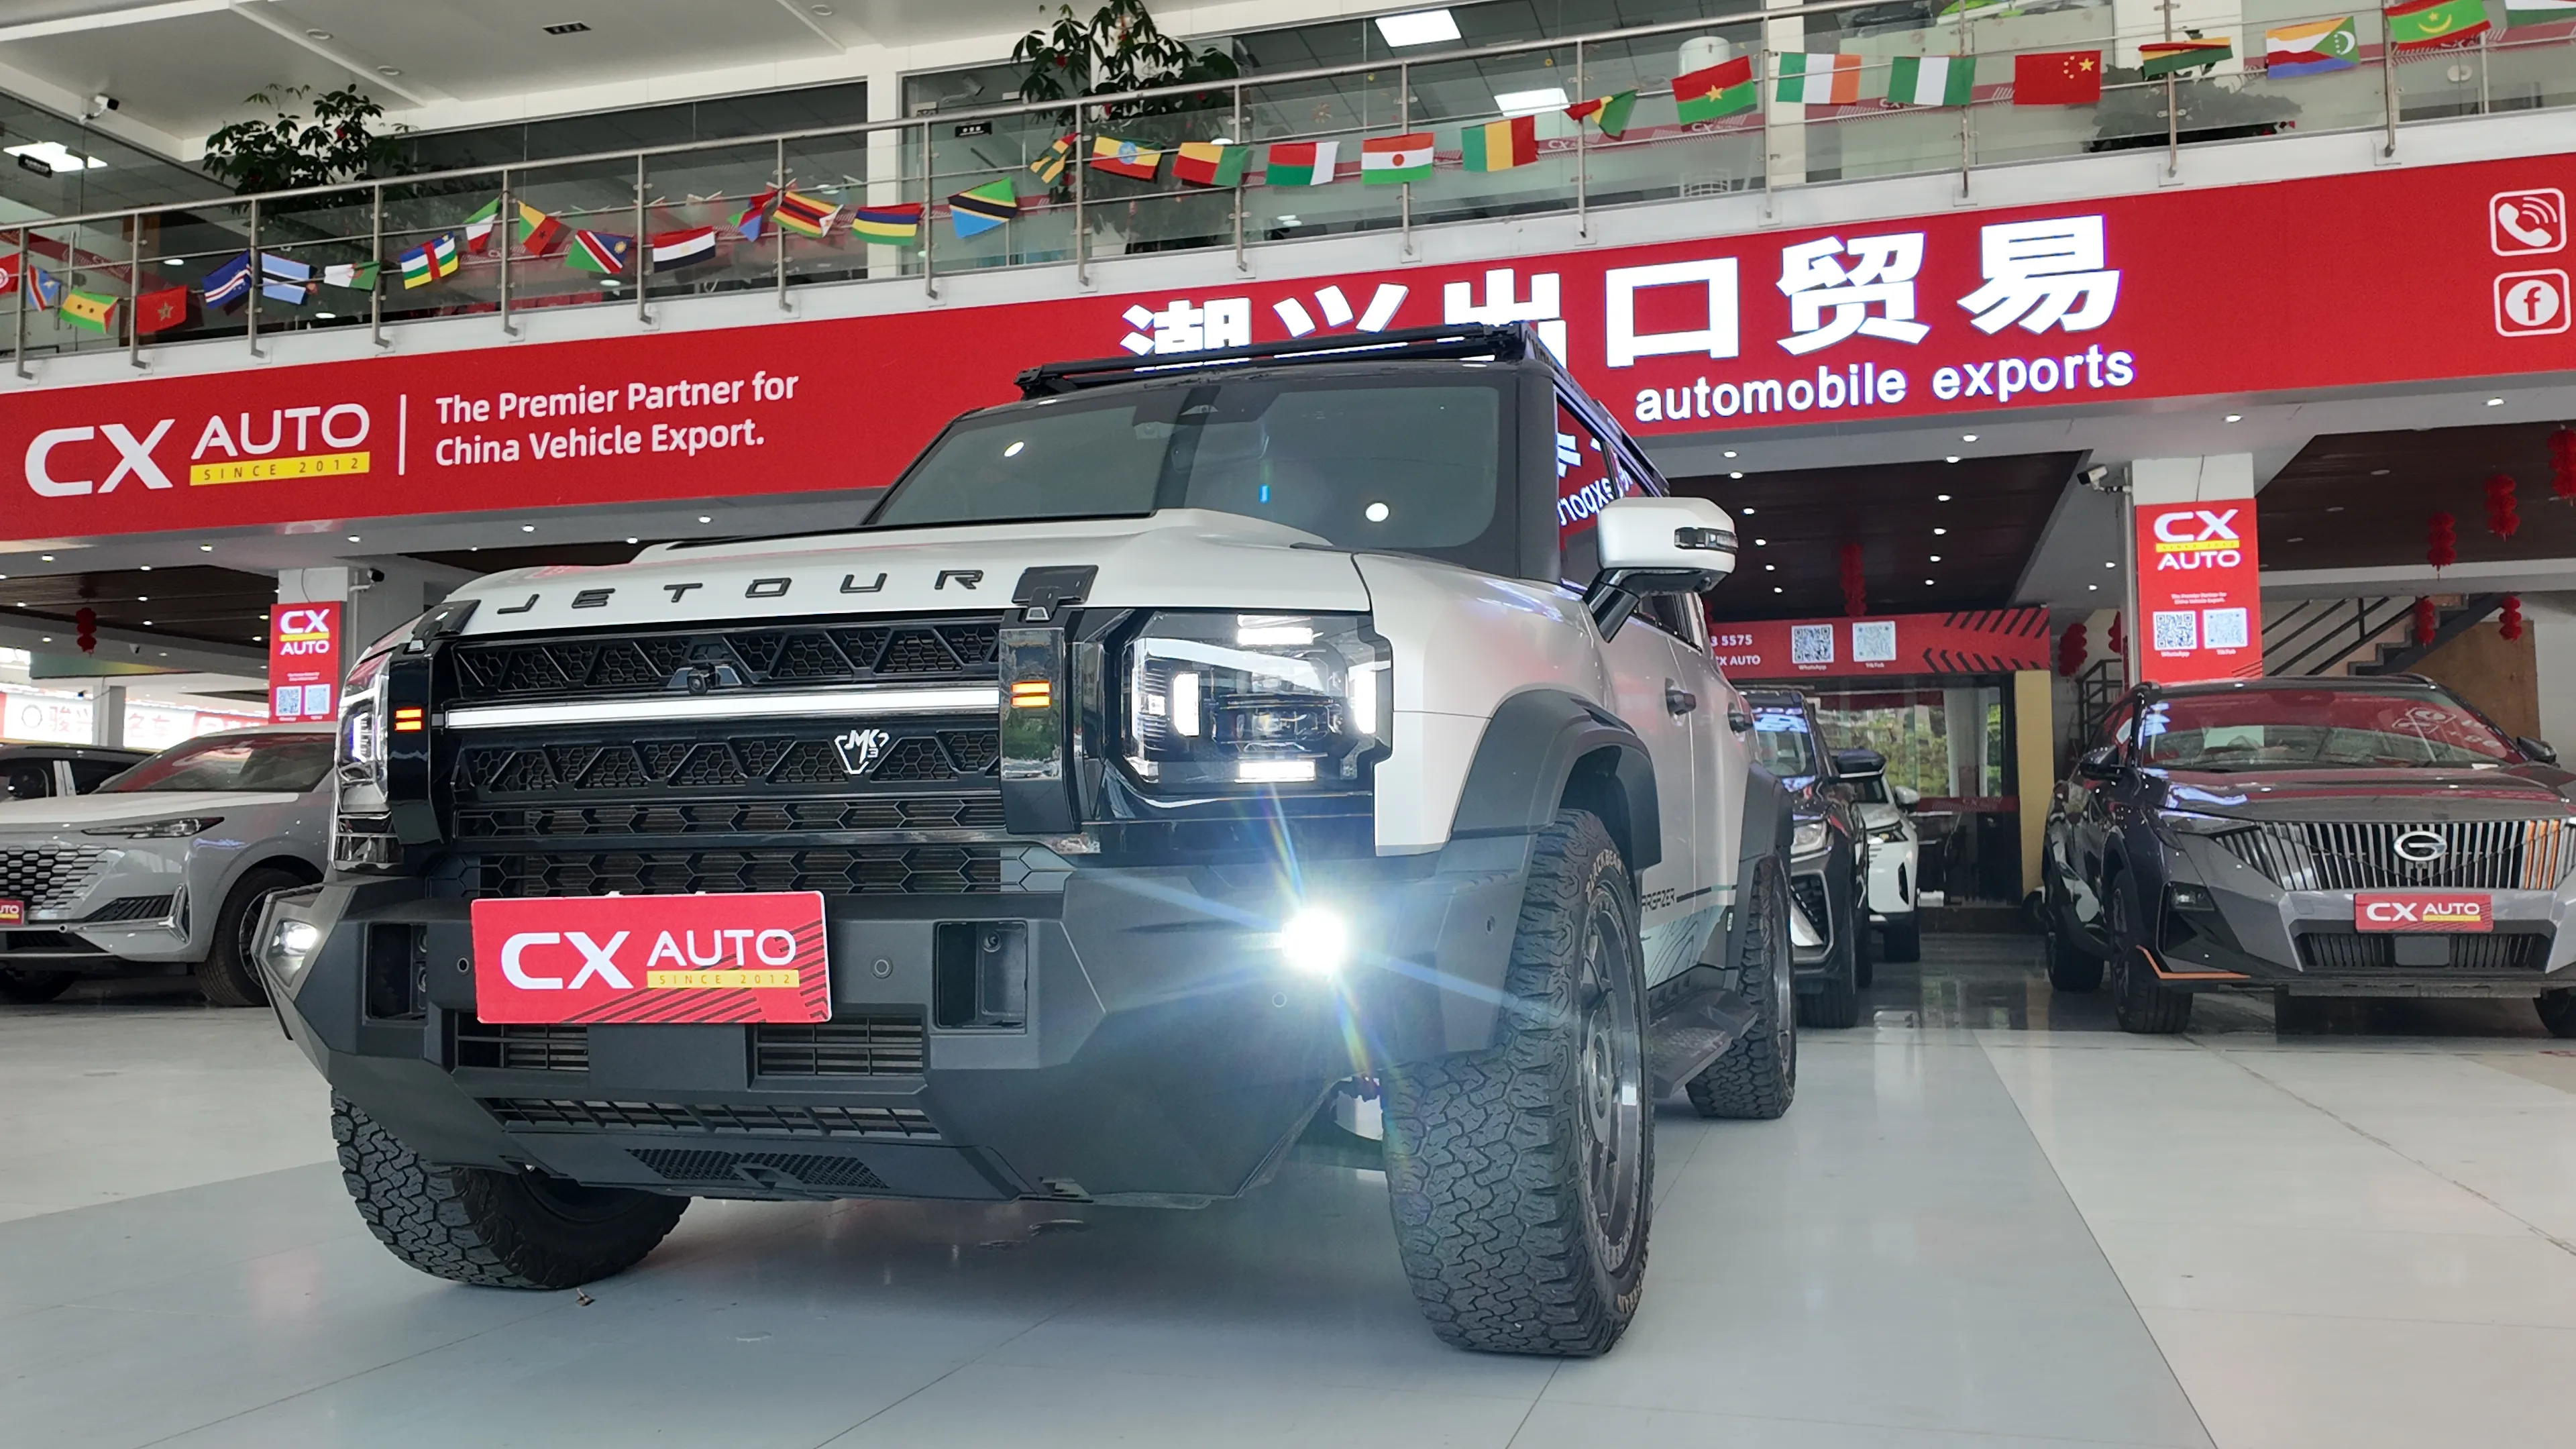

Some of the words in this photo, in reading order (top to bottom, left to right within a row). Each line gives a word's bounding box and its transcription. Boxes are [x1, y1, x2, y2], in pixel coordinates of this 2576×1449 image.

[1634, 362, 1908, 422] automobile
[1932, 343, 2135, 402] exports
[435, 394, 490, 425] The
[498, 384, 619, 421] Premier
[627, 377, 745, 411] Partner
[751, 370, 800, 402] for
[24, 418, 176, 497] CX
[191, 403, 370, 460] AUTO
[435, 434, 521, 466] China
[529, 423, 642, 460] Vehicle
[651, 418, 765, 457] Export.
[203, 463, 277, 481] SINCE
[299, 457, 359, 474] 2012
[2153, 508, 2239, 543] CX
[2157, 549, 2241, 570] AUTO
[496, 568, 984, 615] JETOUR
[280, 608, 331, 634] CX
[280, 640, 330, 655] AUTO
[1721, 634, 1753, 646] 5575
[1729, 654, 1761, 666] AUTO
[2366, 902, 2418, 922] CX
[2422, 902, 2480, 915] AUTO
[500, 930, 634, 989] CX
[646, 929, 797, 966] AUTO
[659, 975, 723, 985] SINCE
[740, 974, 790, 984] 2012
